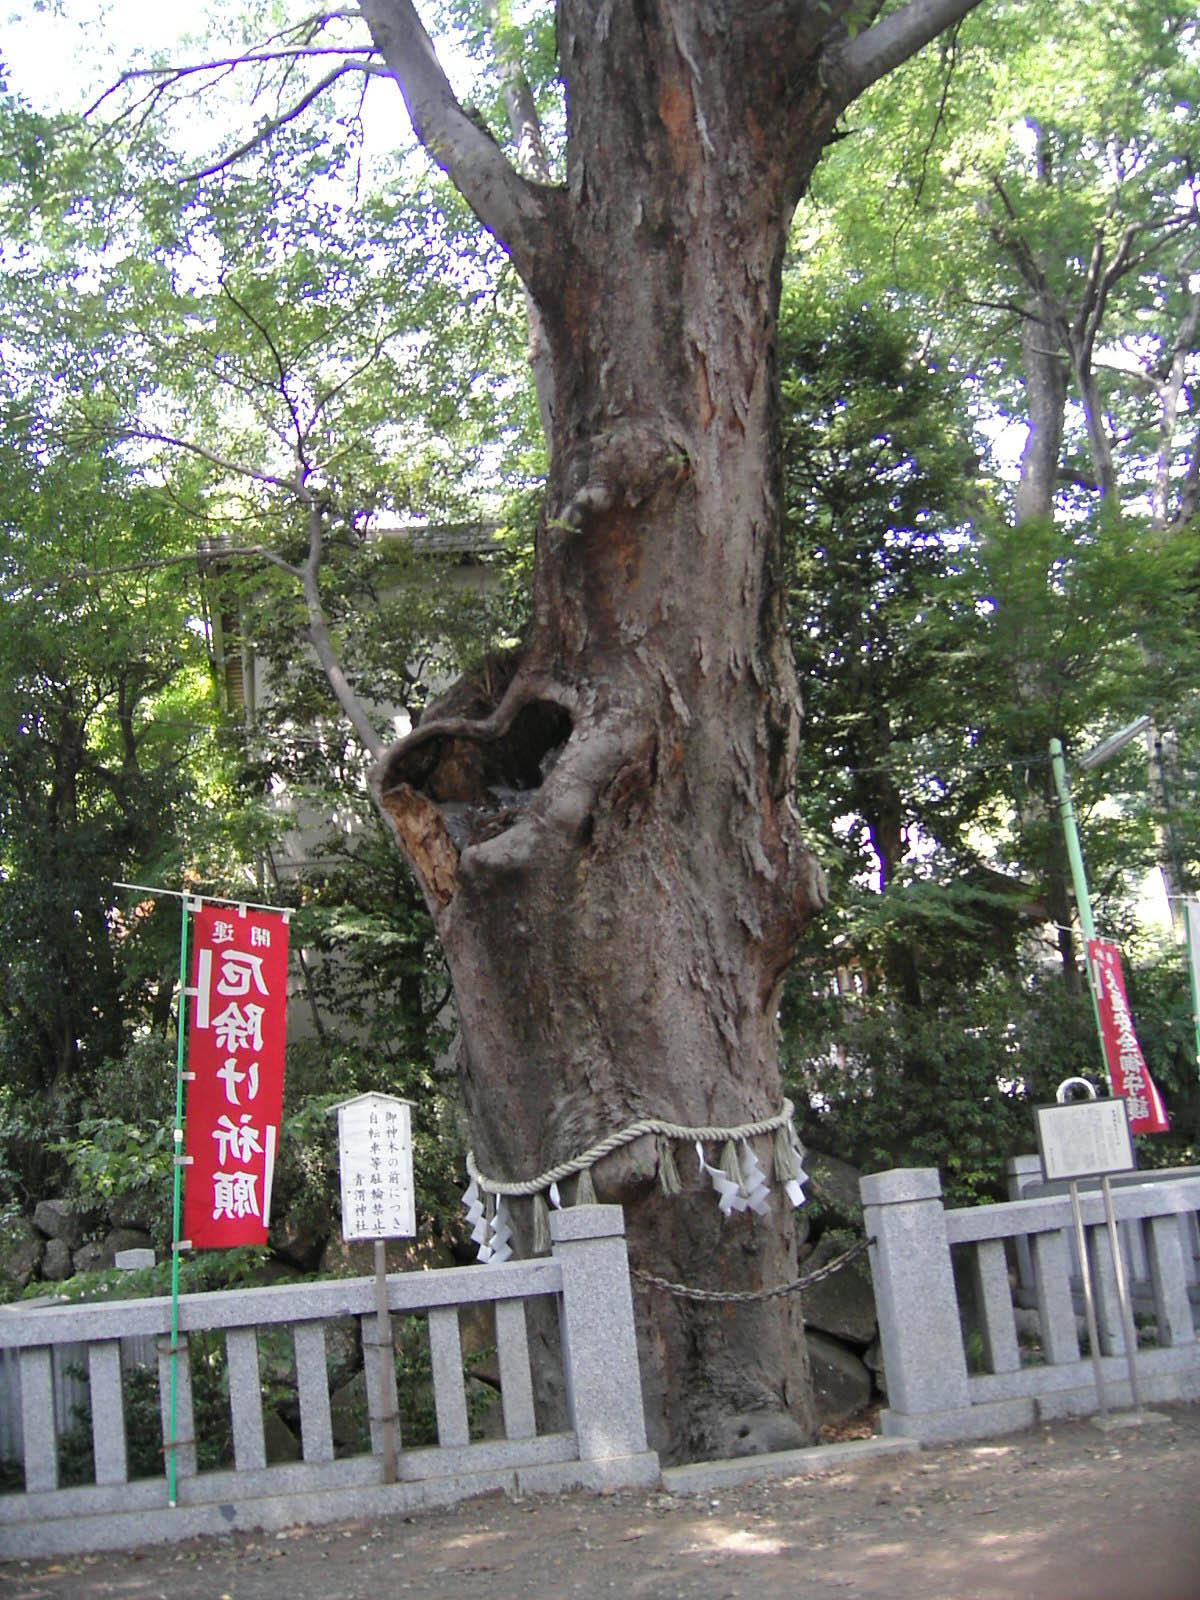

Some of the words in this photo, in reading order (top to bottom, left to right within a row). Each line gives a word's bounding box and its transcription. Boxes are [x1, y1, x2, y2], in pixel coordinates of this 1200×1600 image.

[368, 1110, 386, 1230] 自転車等駐輪禁止
[385, 1110, 401, 1230] 御神木の前につき
